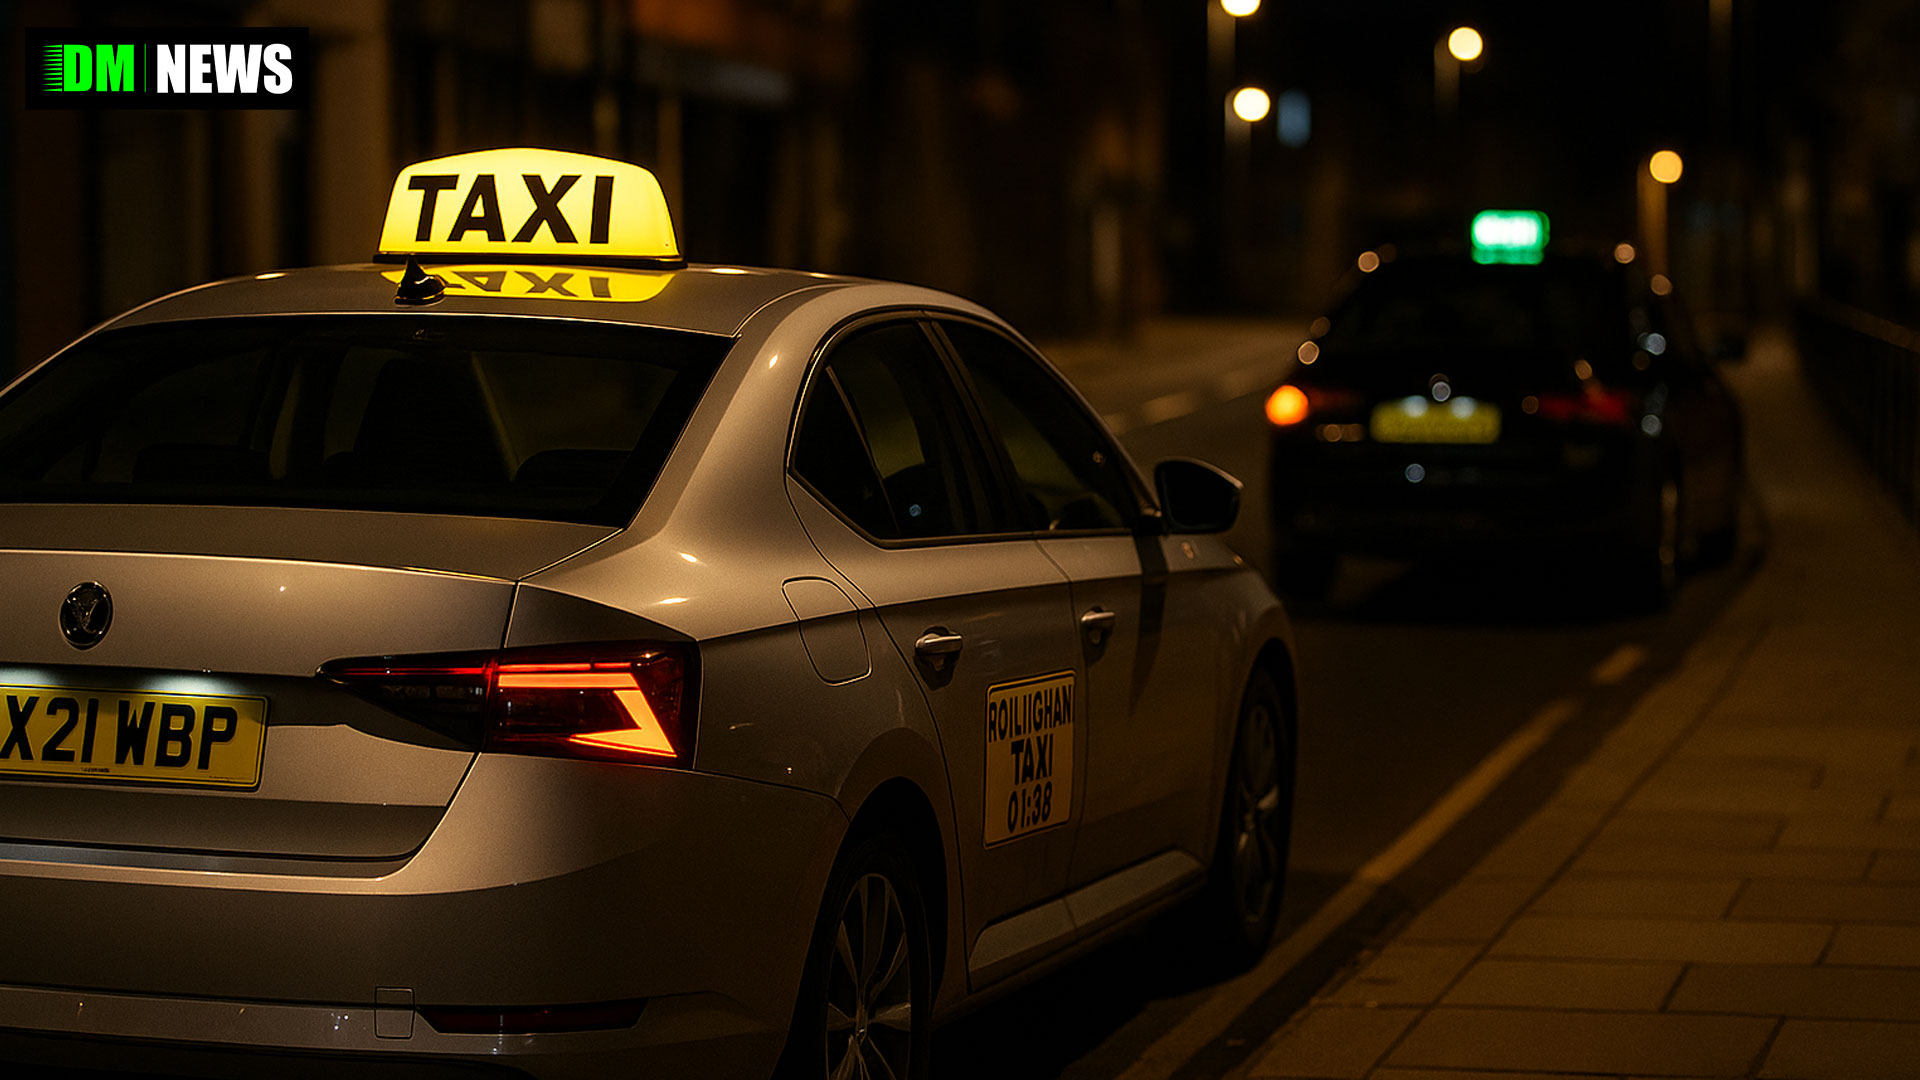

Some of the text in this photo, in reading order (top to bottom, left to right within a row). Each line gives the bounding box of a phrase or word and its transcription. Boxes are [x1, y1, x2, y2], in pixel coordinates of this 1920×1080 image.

[408, 174, 615, 244] TAXI
[0, 695, 239, 770] X21 WBP
[1010, 733, 1054, 785] TAXI
[1007, 780, 1053, 834] 01:38
